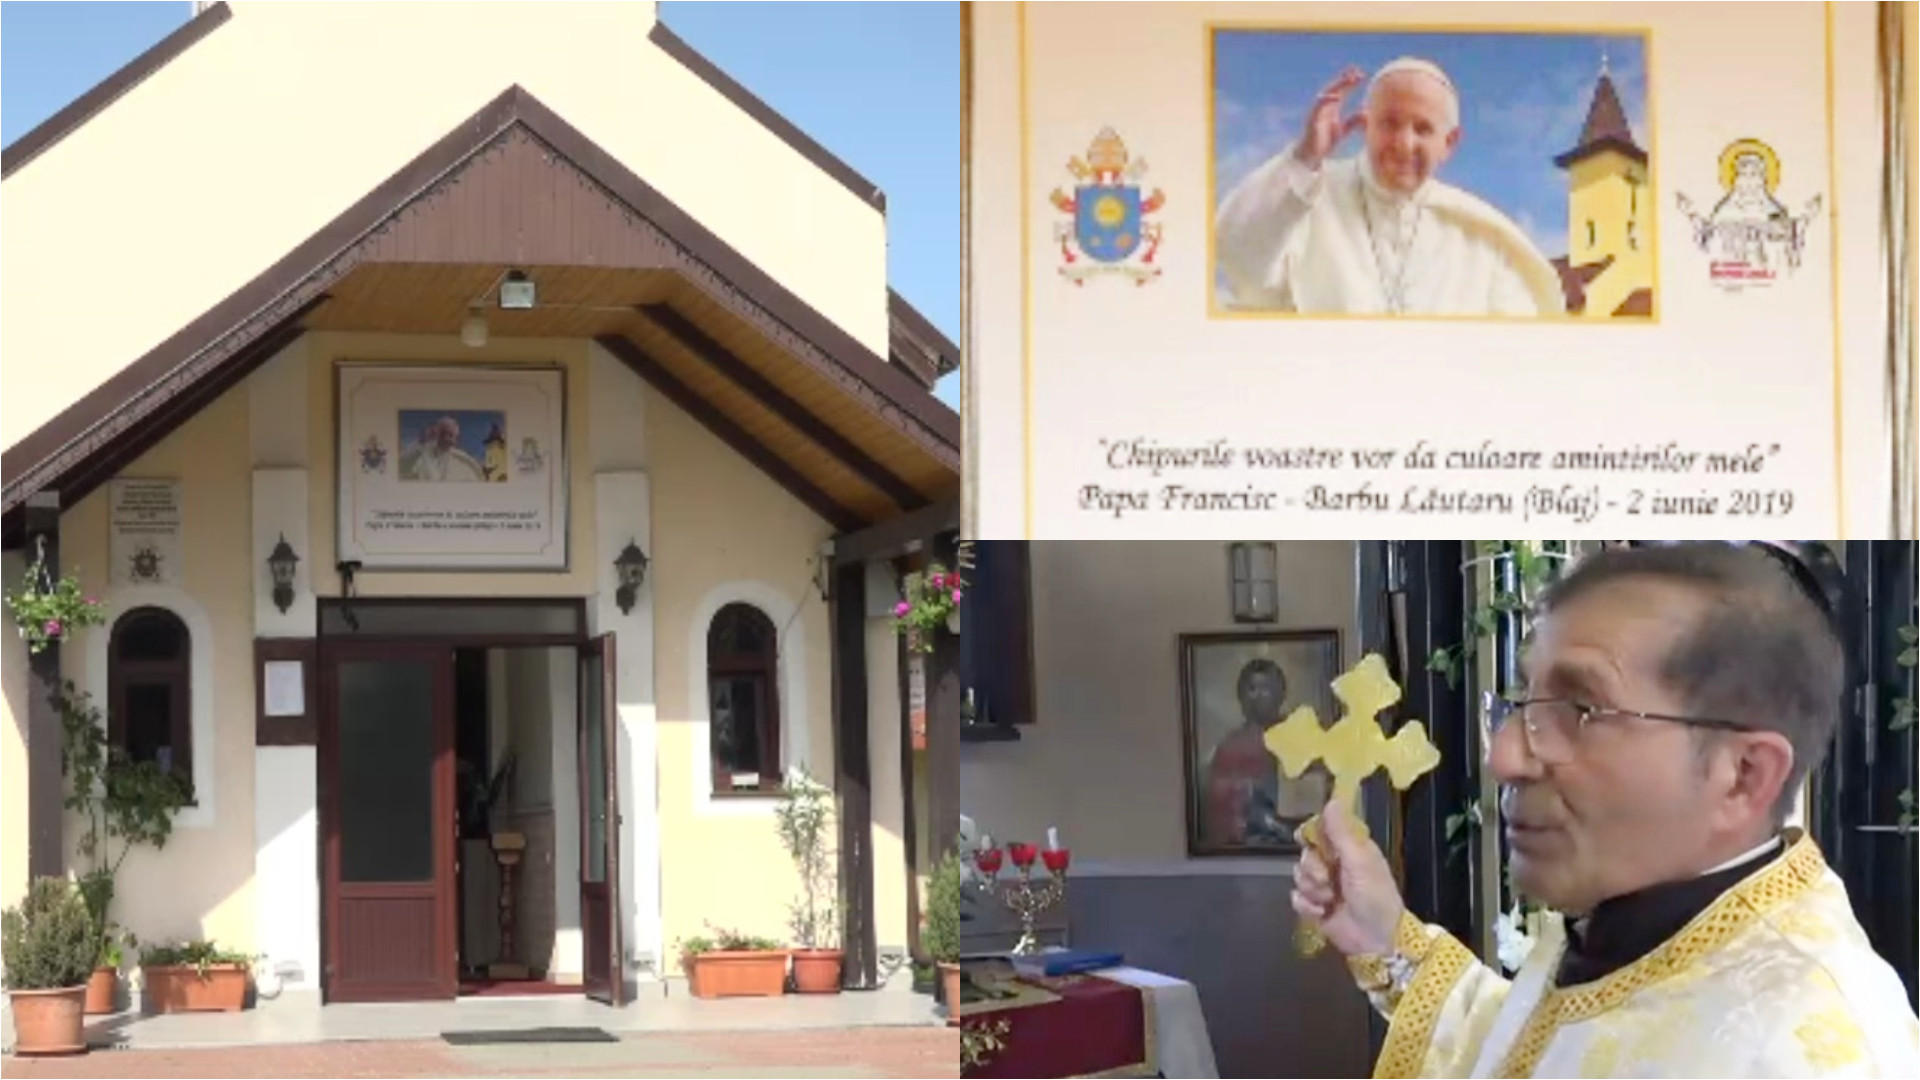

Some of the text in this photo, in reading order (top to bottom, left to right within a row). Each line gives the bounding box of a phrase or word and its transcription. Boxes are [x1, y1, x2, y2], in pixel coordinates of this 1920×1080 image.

[1246, 447, 1343, 470] voastre
[1350, 448, 1396, 470] vor
[1403, 439, 1437, 470] da
[1445, 439, 1542, 470] culoare
[1549, 442, 1699, 473] amintirilor
[1078, 484, 1150, 519] Papa
[1160, 484, 1278, 511] Francisc
[1304, 481, 1389, 512] Barbu
[1522, 483, 1600, 523] (Blaj)
[1626, 487, 1646, 515] 2
[1651, 488, 1720, 515] iunie
[1725, 487, 1795, 515] 2019
